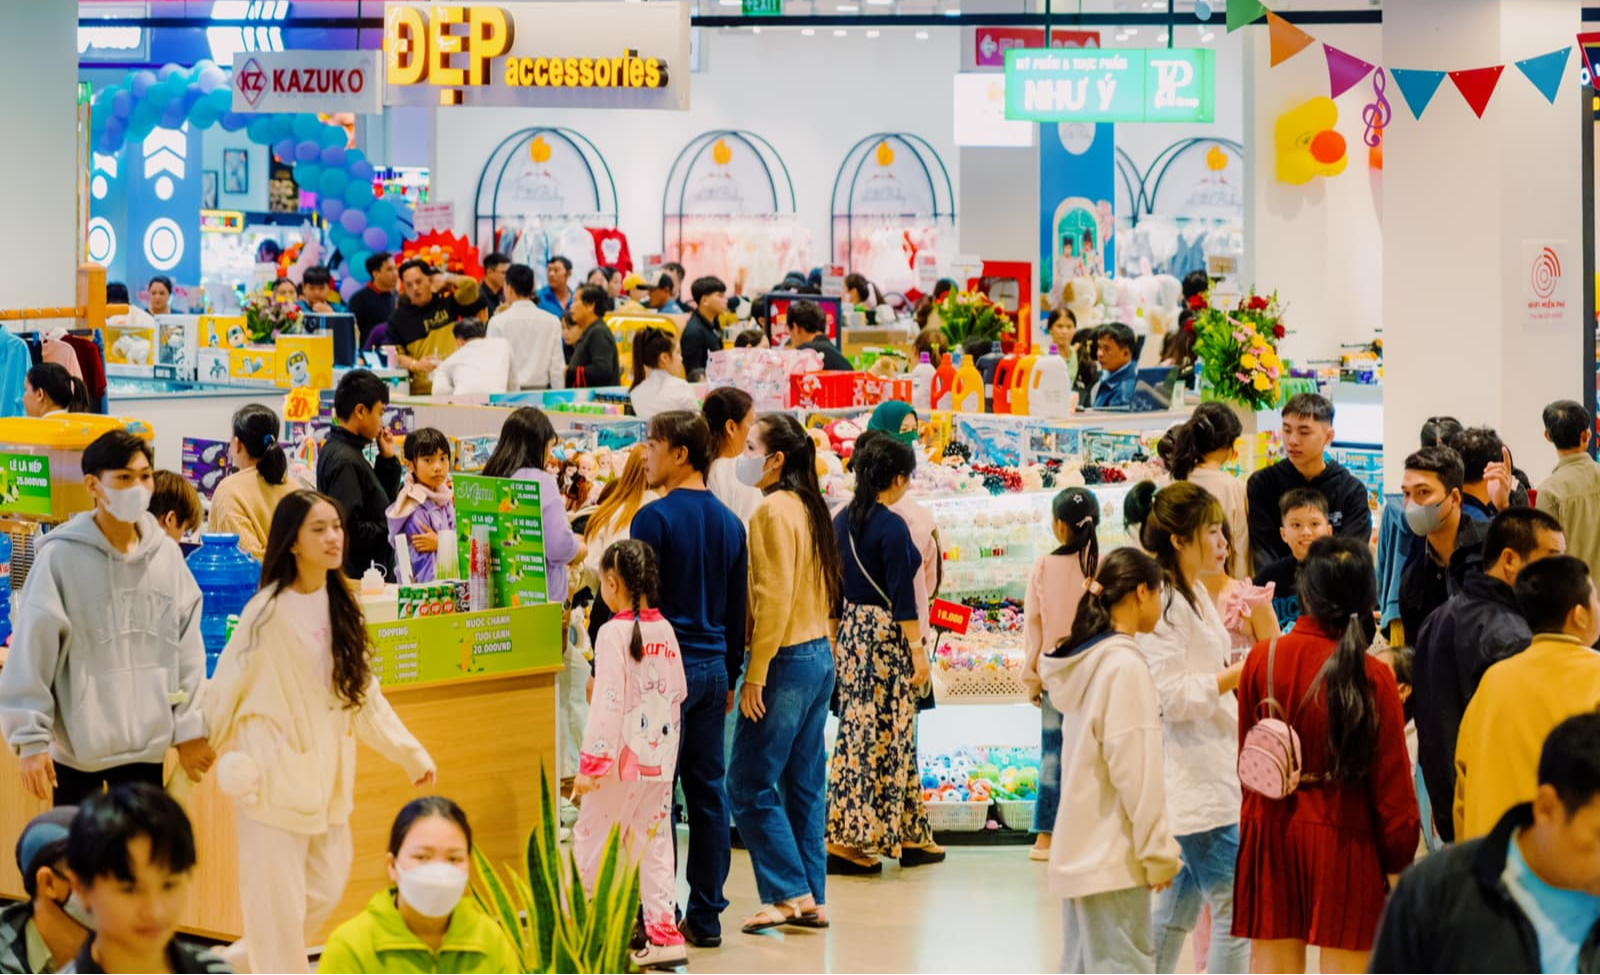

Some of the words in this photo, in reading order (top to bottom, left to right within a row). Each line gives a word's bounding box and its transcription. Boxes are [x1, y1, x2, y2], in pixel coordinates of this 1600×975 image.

[383, 6, 514, 106] ĐẸP
[505, 48, 664, 88] accessories
[241, 70, 263, 92] KZ
[273, 69, 364, 94] KAZUKO
[1024, 76, 1089, 111] NHƯ
[1096, 72, 1117, 111] Ý
[377, 626, 409, 639] TOPPING
[473, 641, 512, 654] 20.000VND
